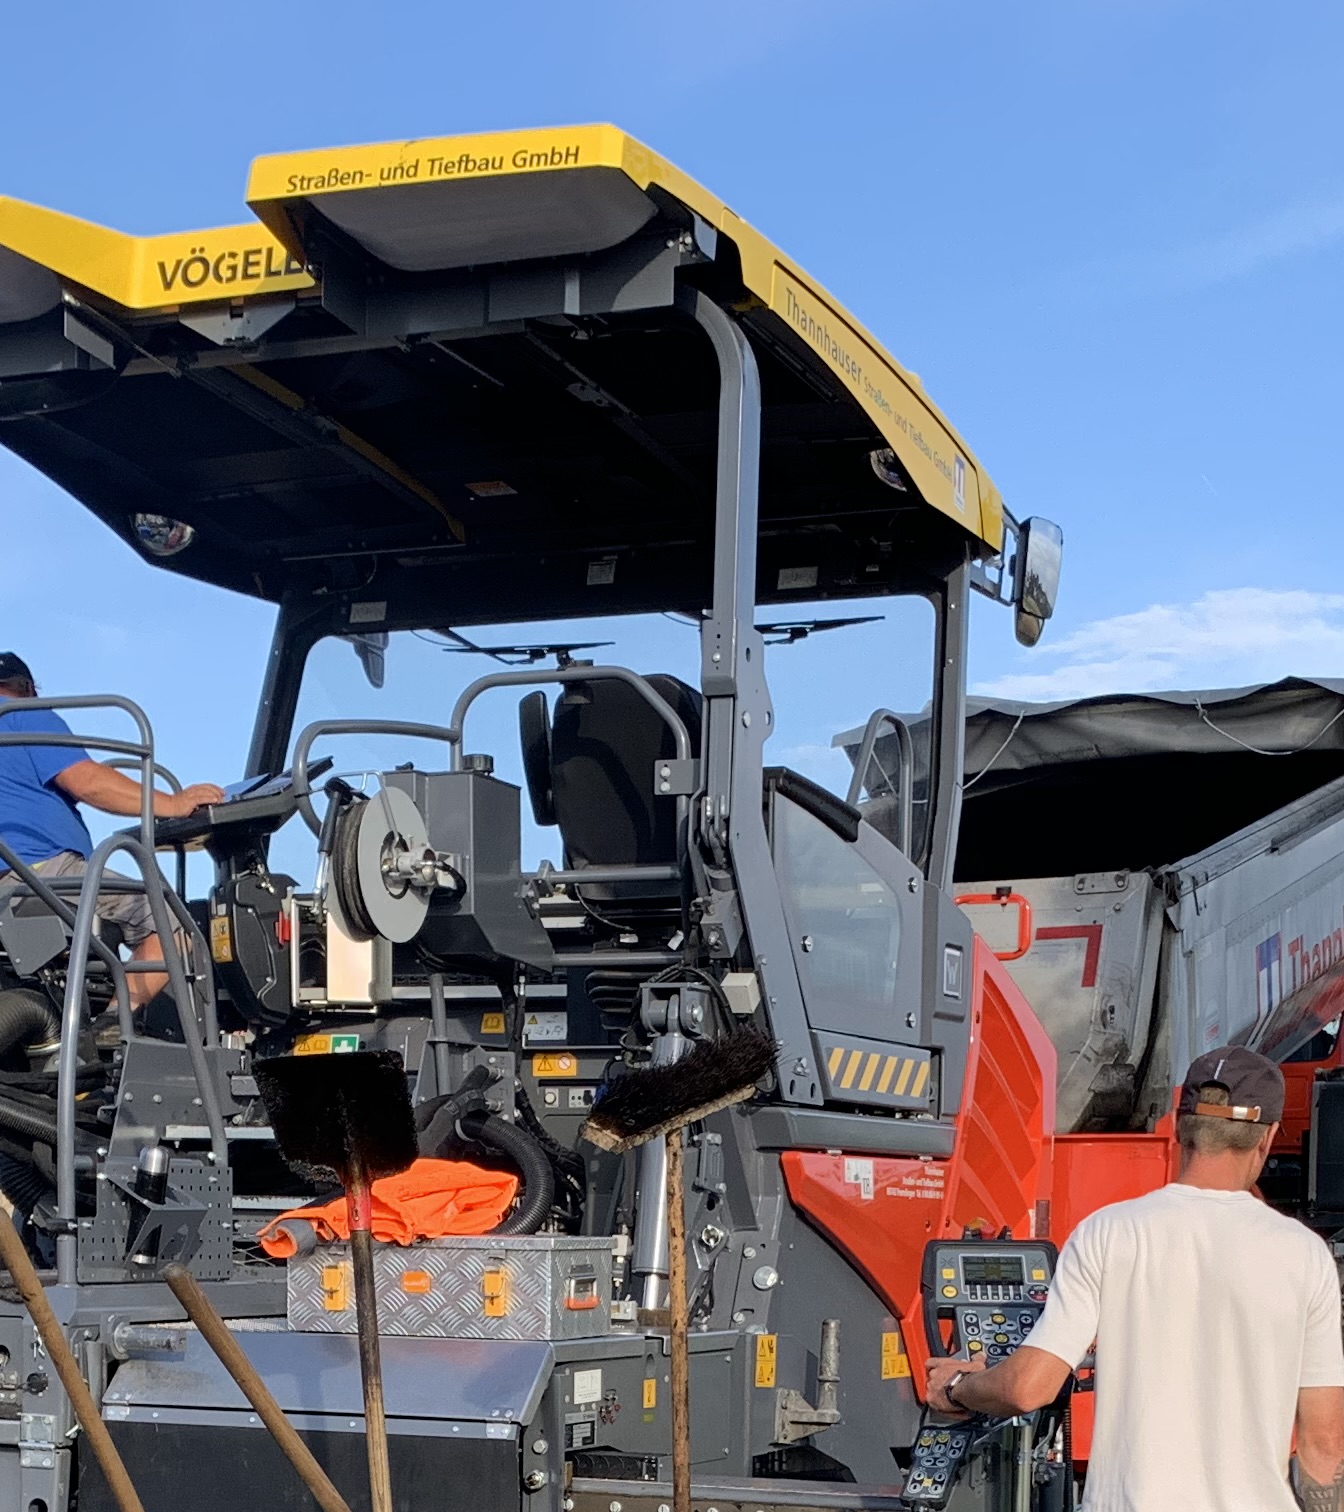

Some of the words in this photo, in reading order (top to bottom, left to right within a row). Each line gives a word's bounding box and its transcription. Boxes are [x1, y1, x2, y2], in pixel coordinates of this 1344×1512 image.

[286, 168, 372, 193] Straßen-
[379, 158, 419, 181] und
[427, 153, 504, 176] Tiefbau
[512, 145, 580, 168] GmbH
[786, 287, 862, 385] Thannhauser
